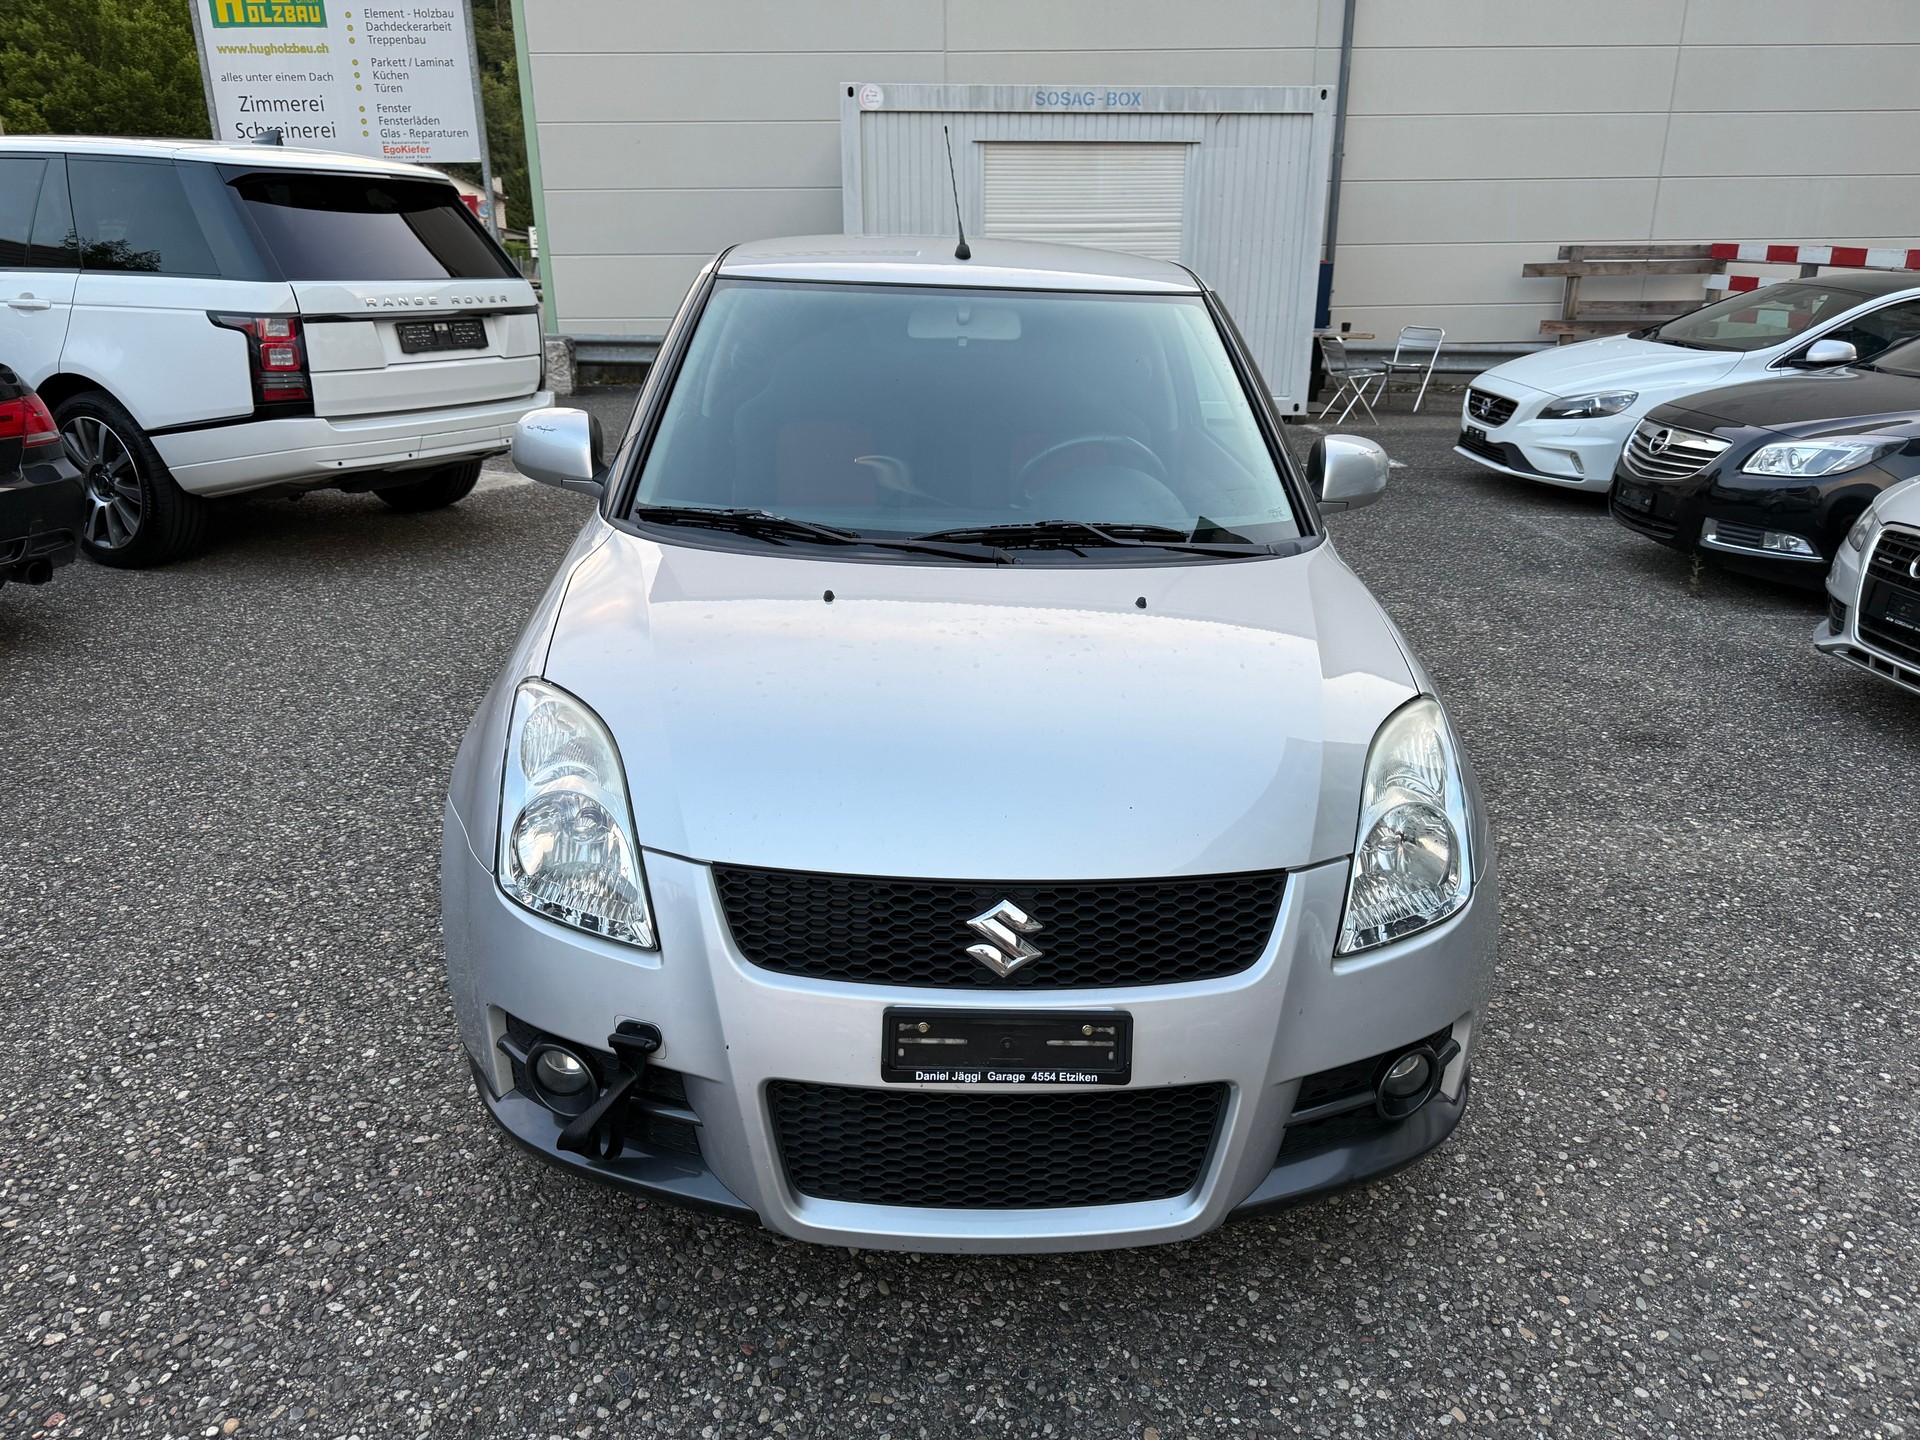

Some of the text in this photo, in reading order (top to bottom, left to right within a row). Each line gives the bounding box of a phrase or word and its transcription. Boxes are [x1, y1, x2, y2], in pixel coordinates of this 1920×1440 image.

[364, 8, 405, 19] Element
[413, 8, 455, 19] Holzbau
[365, 21, 452, 32] Dachdeckerarbeit
[367, 34, 426, 46] Treppenbau
[216, 42, 329, 56] www.hugholzbau.ch
[371, 57, 407, 68] Parkett
[414, 57, 455, 68] Laminat
[220, 72, 334, 82] alles unter einem Dach
[372, 70, 410, 81] Küchen
[374, 83, 403, 94] Türen
[237, 94, 325, 112] Zimmerei
[376, 103, 412, 114] Fenster
[378, 116, 440, 127] Fensterläden
[380, 128, 400, 139] Glas
[409, 128, 469, 141] Reparaturen
[383, 145, 431, 156] EgoKiefer
[365, 295, 508, 308] RANGE ROVER
[915, 1071, 1098, 1083] Daniel Jäggi Garage 4554 Etziken
